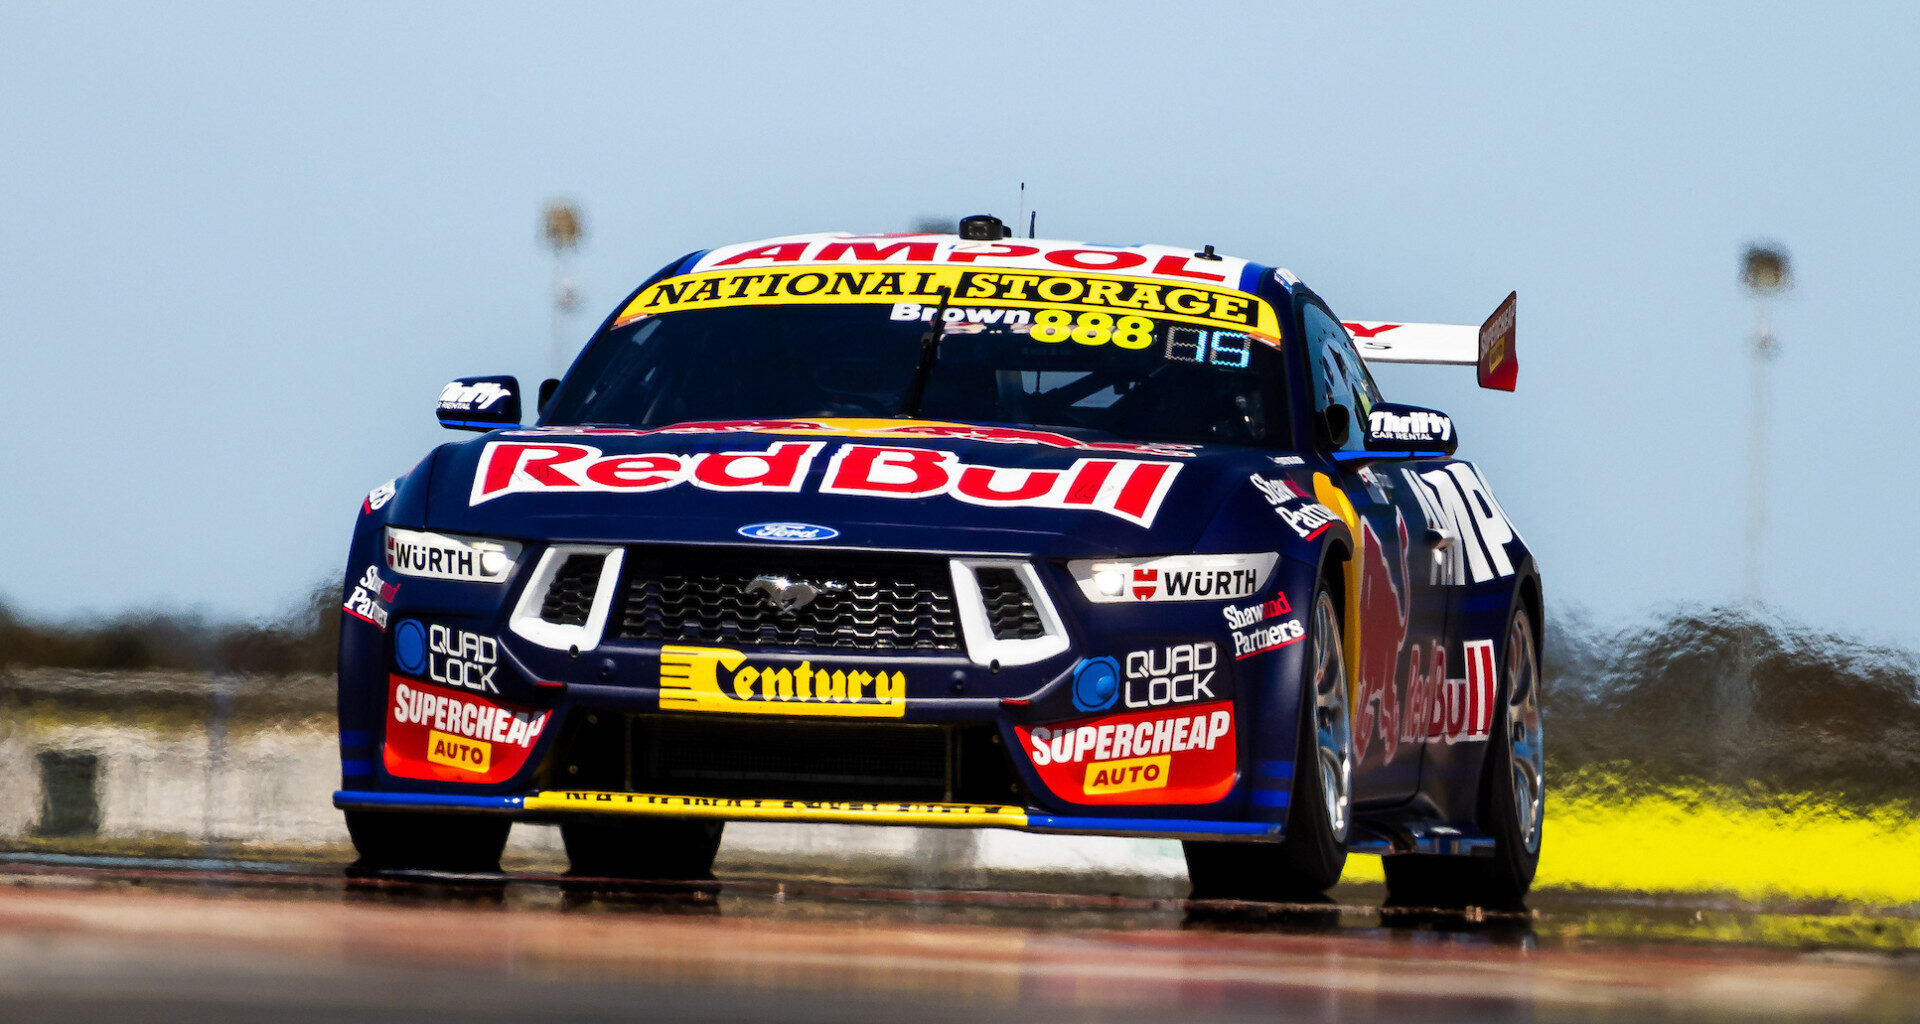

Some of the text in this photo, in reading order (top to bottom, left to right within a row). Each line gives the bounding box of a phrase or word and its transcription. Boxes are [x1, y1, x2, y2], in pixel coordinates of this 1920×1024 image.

[711, 241, 1227, 282] AMPOL
[649, 271, 1249, 322] NATIONAL STORAGE
[889, 303, 1030, 325] Brown
[1030, 309, 1155, 350] 888
[1368, 411, 1451, 441] Thrifty
[1371, 431, 1434, 441] CAR RENTAL
[474, 442, 812, 503] Red
[826, 444, 1178, 523] Bull
[756, 524, 819, 538] Ford
[1401, 462, 1536, 586] AMP
[395, 542, 473, 576] WÜRTH
[1164, 568, 1257, 596] WÜRTH
[429, 624, 498, 665] QUAD
[1232, 619, 1305, 657] Partners
[429, 653, 500, 695] LOCK
[697, 646, 906, 708] Century
[1126, 641, 1218, 678] QUAD
[1125, 671, 1216, 709] LOCK
[394, 683, 546, 748] SUPERCHEAP
[434, 739, 483, 765] AUTO
[1031, 710, 1231, 766] SUPERCHEAP
[1093, 764, 1161, 787] AUTO
